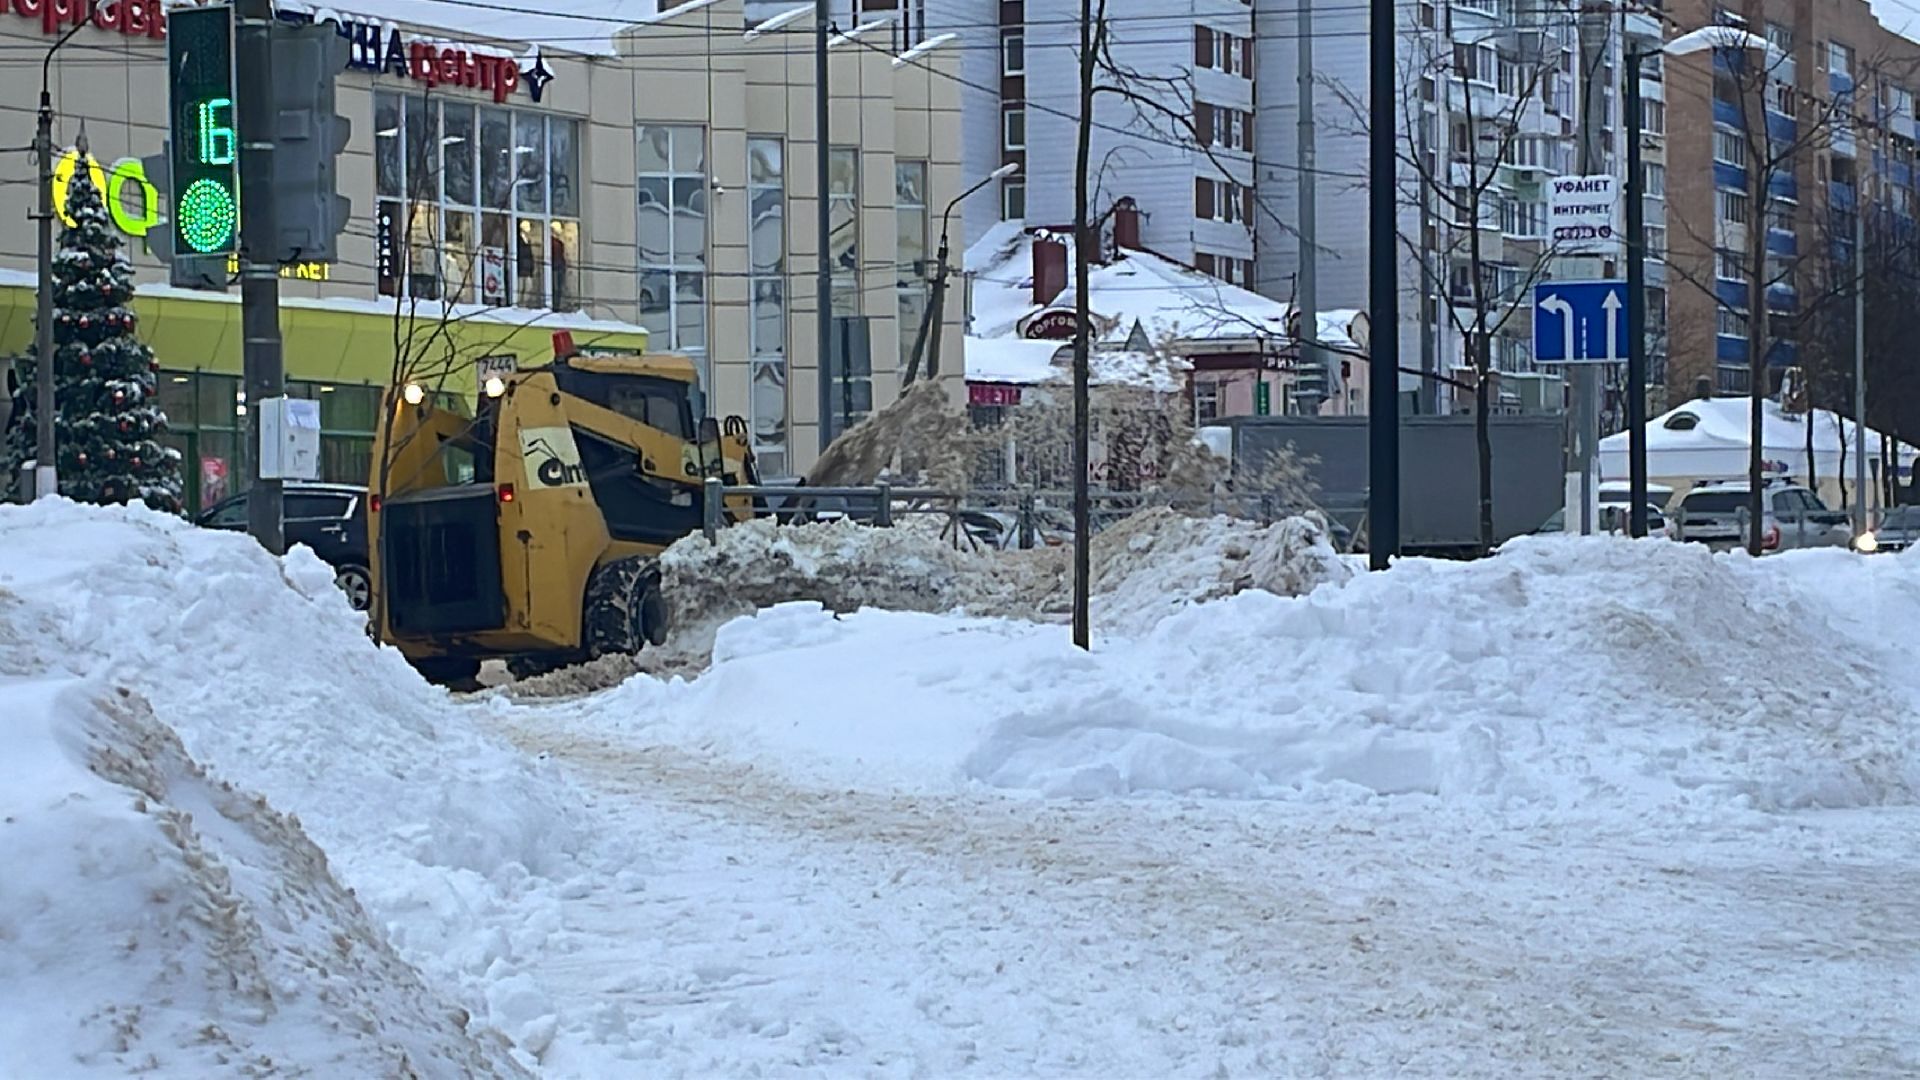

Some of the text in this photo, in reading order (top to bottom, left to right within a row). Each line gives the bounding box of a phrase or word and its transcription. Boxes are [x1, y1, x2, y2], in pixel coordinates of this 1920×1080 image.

[200, 98, 234, 165] 16
[1553, 180, 1610, 194] УФАНЕТ
[1553, 203, 1610, 216] ИНТЕРНЕТ
[1027, 315, 1079, 338] ТОРГОВ
